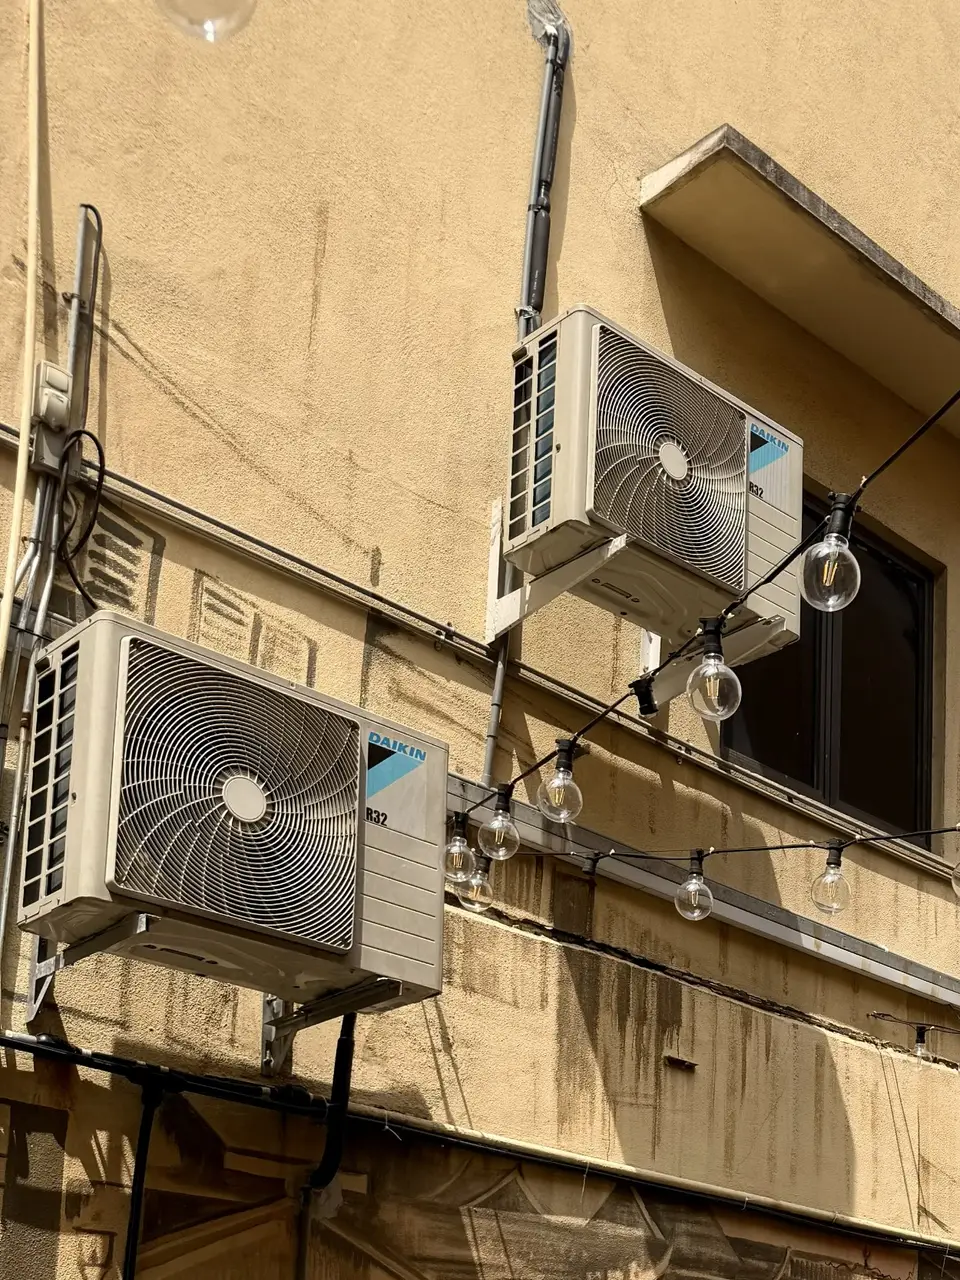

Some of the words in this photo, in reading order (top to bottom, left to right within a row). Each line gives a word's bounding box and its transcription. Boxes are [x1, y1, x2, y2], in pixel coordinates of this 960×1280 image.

[750, 423, 789, 452] DAIKIN
[749, 481, 764, 498] R32
[368, 731, 427, 761] DAIKIN
[366, 807, 388, 827] R32
